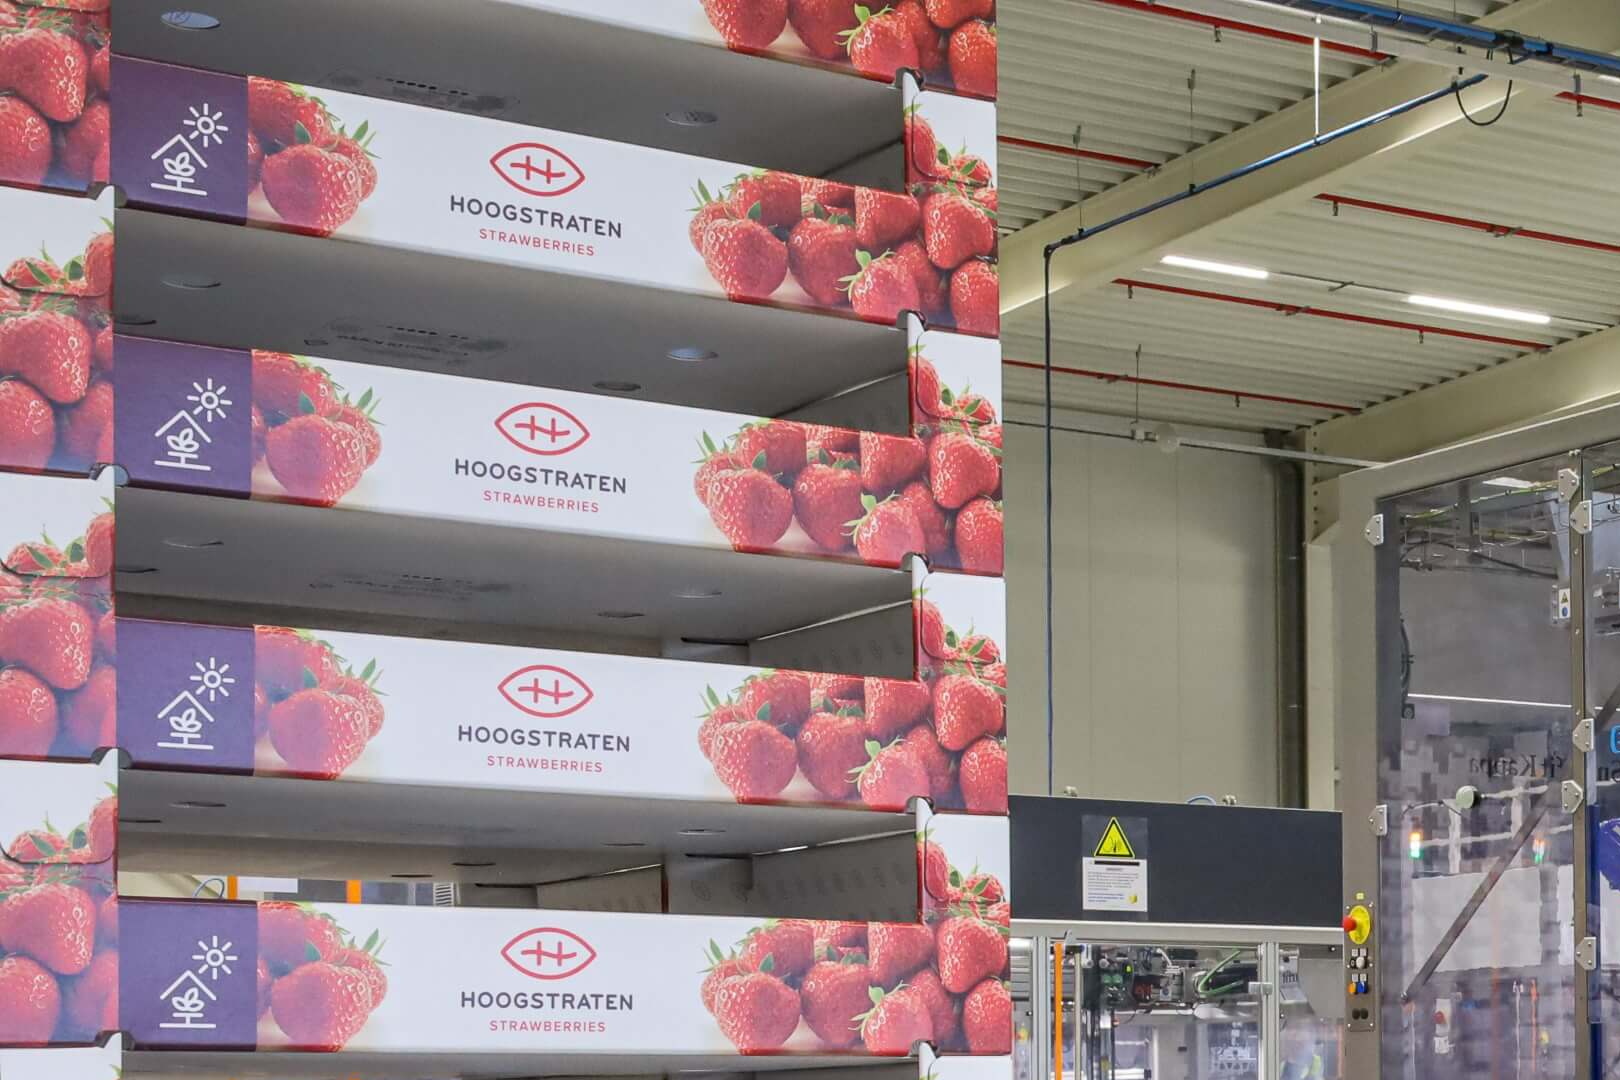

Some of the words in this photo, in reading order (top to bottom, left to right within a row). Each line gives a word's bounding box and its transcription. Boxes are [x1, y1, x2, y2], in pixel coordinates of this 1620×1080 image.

[450, 194, 622, 239] HOOGSTRATEN
[479, 228, 595, 257] STRAWBERRIES
[455, 458, 626, 494] HOOGSTRATEN
[482, 489, 600, 513] STRAWBERRIES
[458, 725, 630, 752] HOOGSTRATEN
[486, 754, 603, 774] STRAWBERRIES
[461, 991, 633, 1011] HOOGSTRATEN
[488, 1019, 606, 1033] STRAWBERRIES
